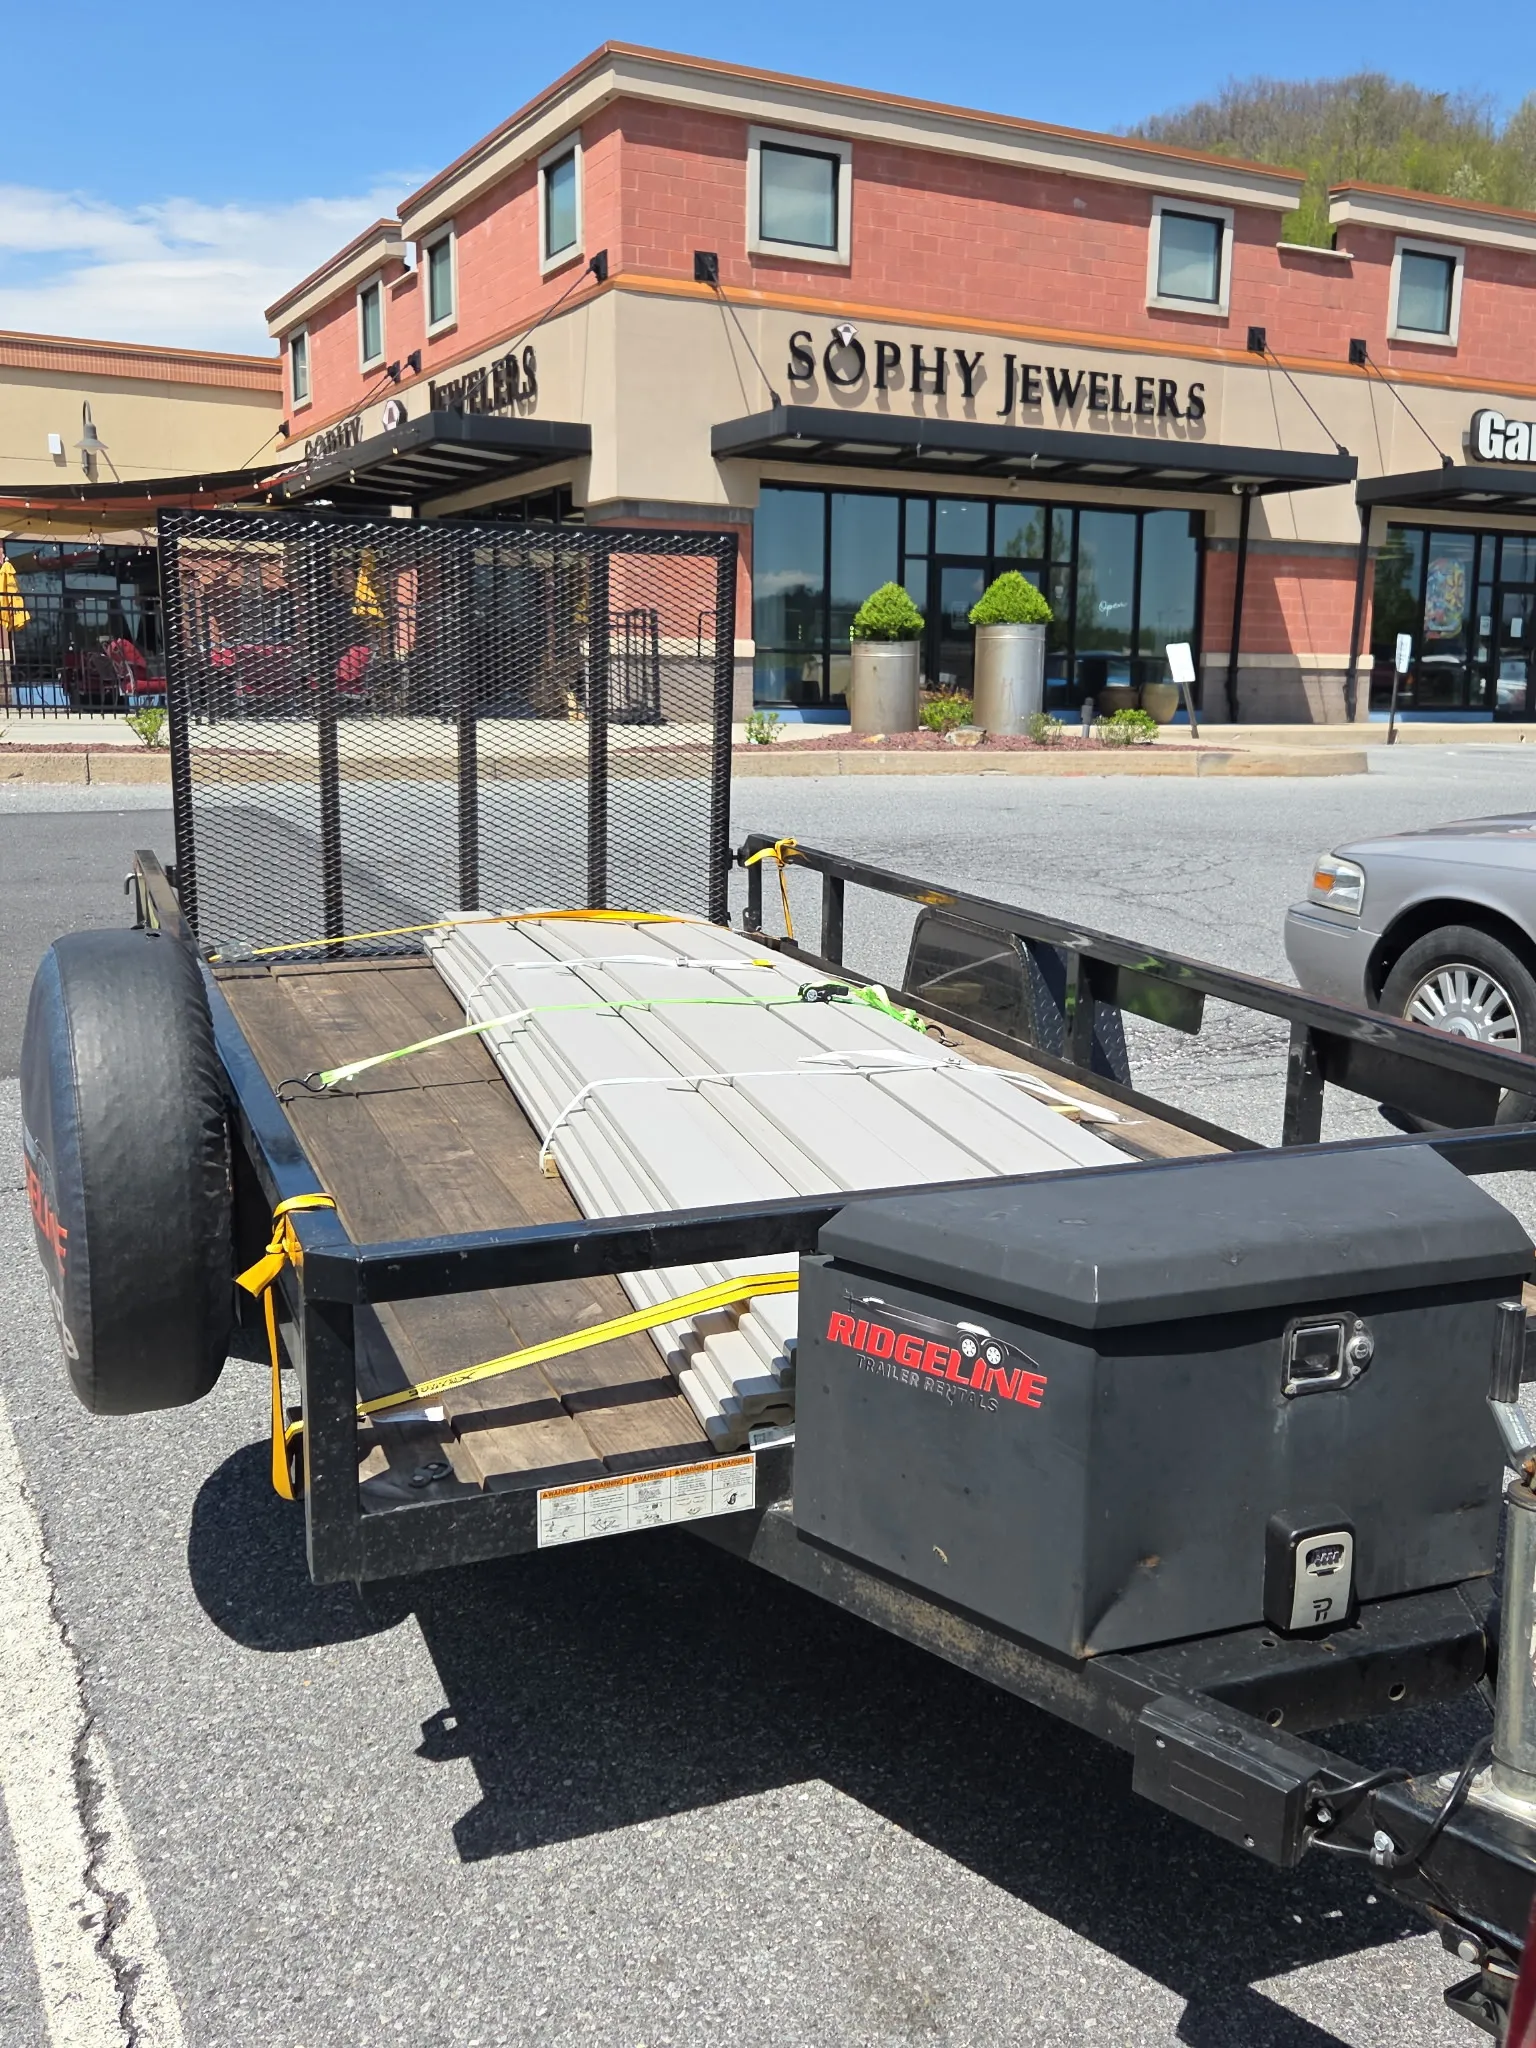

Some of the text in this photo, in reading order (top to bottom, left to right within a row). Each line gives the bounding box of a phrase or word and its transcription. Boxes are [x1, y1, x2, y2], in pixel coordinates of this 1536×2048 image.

[787, 328, 1206, 420] SOPHY JEWELERS
[1478, 410, 1536, 462] Ga
[1098, 600, 1128, 617] Open
[826, 1310, 1048, 1408] RIDGELINE
[856, 1353, 1000, 1413] TRAILER RENTALS
[721, 1455, 750, 1467] WARNING
[636, 1470, 667, 1482] WARNING
[679, 1463, 709, 1475] WARNING
[593, 1478, 624, 1490] WARNING
[547, 1486, 579, 1498] WARNING
